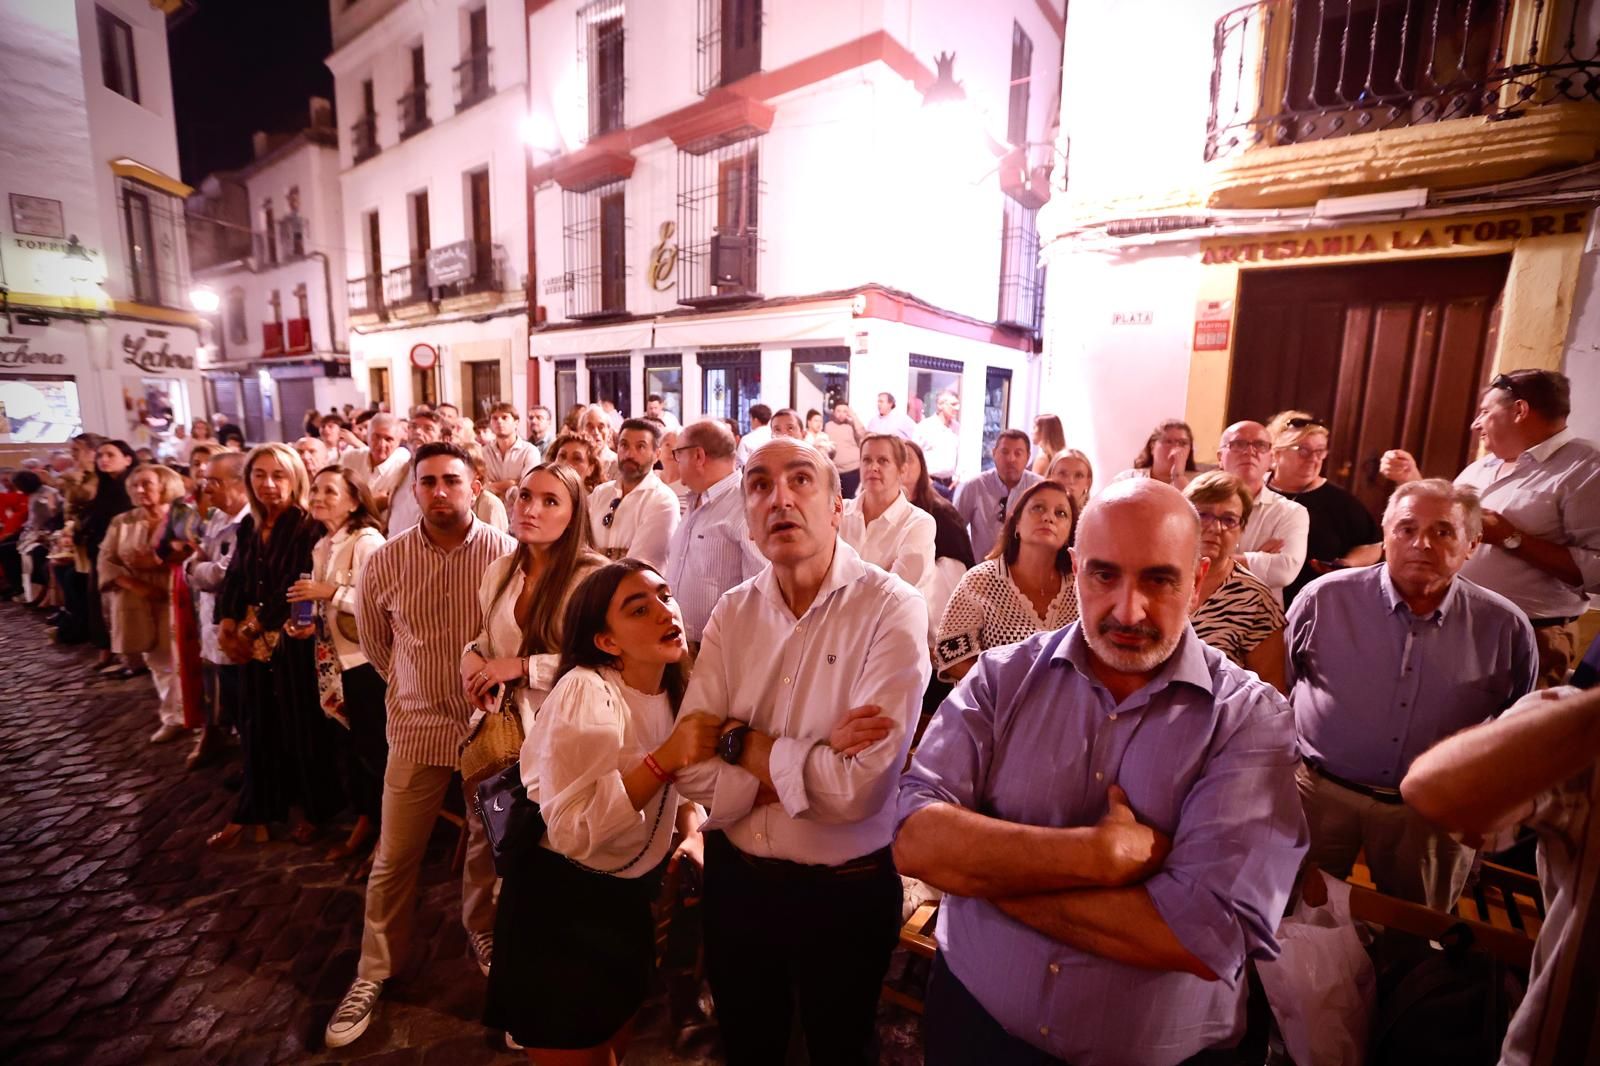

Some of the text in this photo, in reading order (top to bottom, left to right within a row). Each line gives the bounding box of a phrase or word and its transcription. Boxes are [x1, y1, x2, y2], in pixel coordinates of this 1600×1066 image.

[1392, 218, 1435, 249] LA
[1444, 211, 1586, 245] TORRE
[15, 238, 98, 256] TORRIS
[1112, 312, 1153, 324] PLATA
